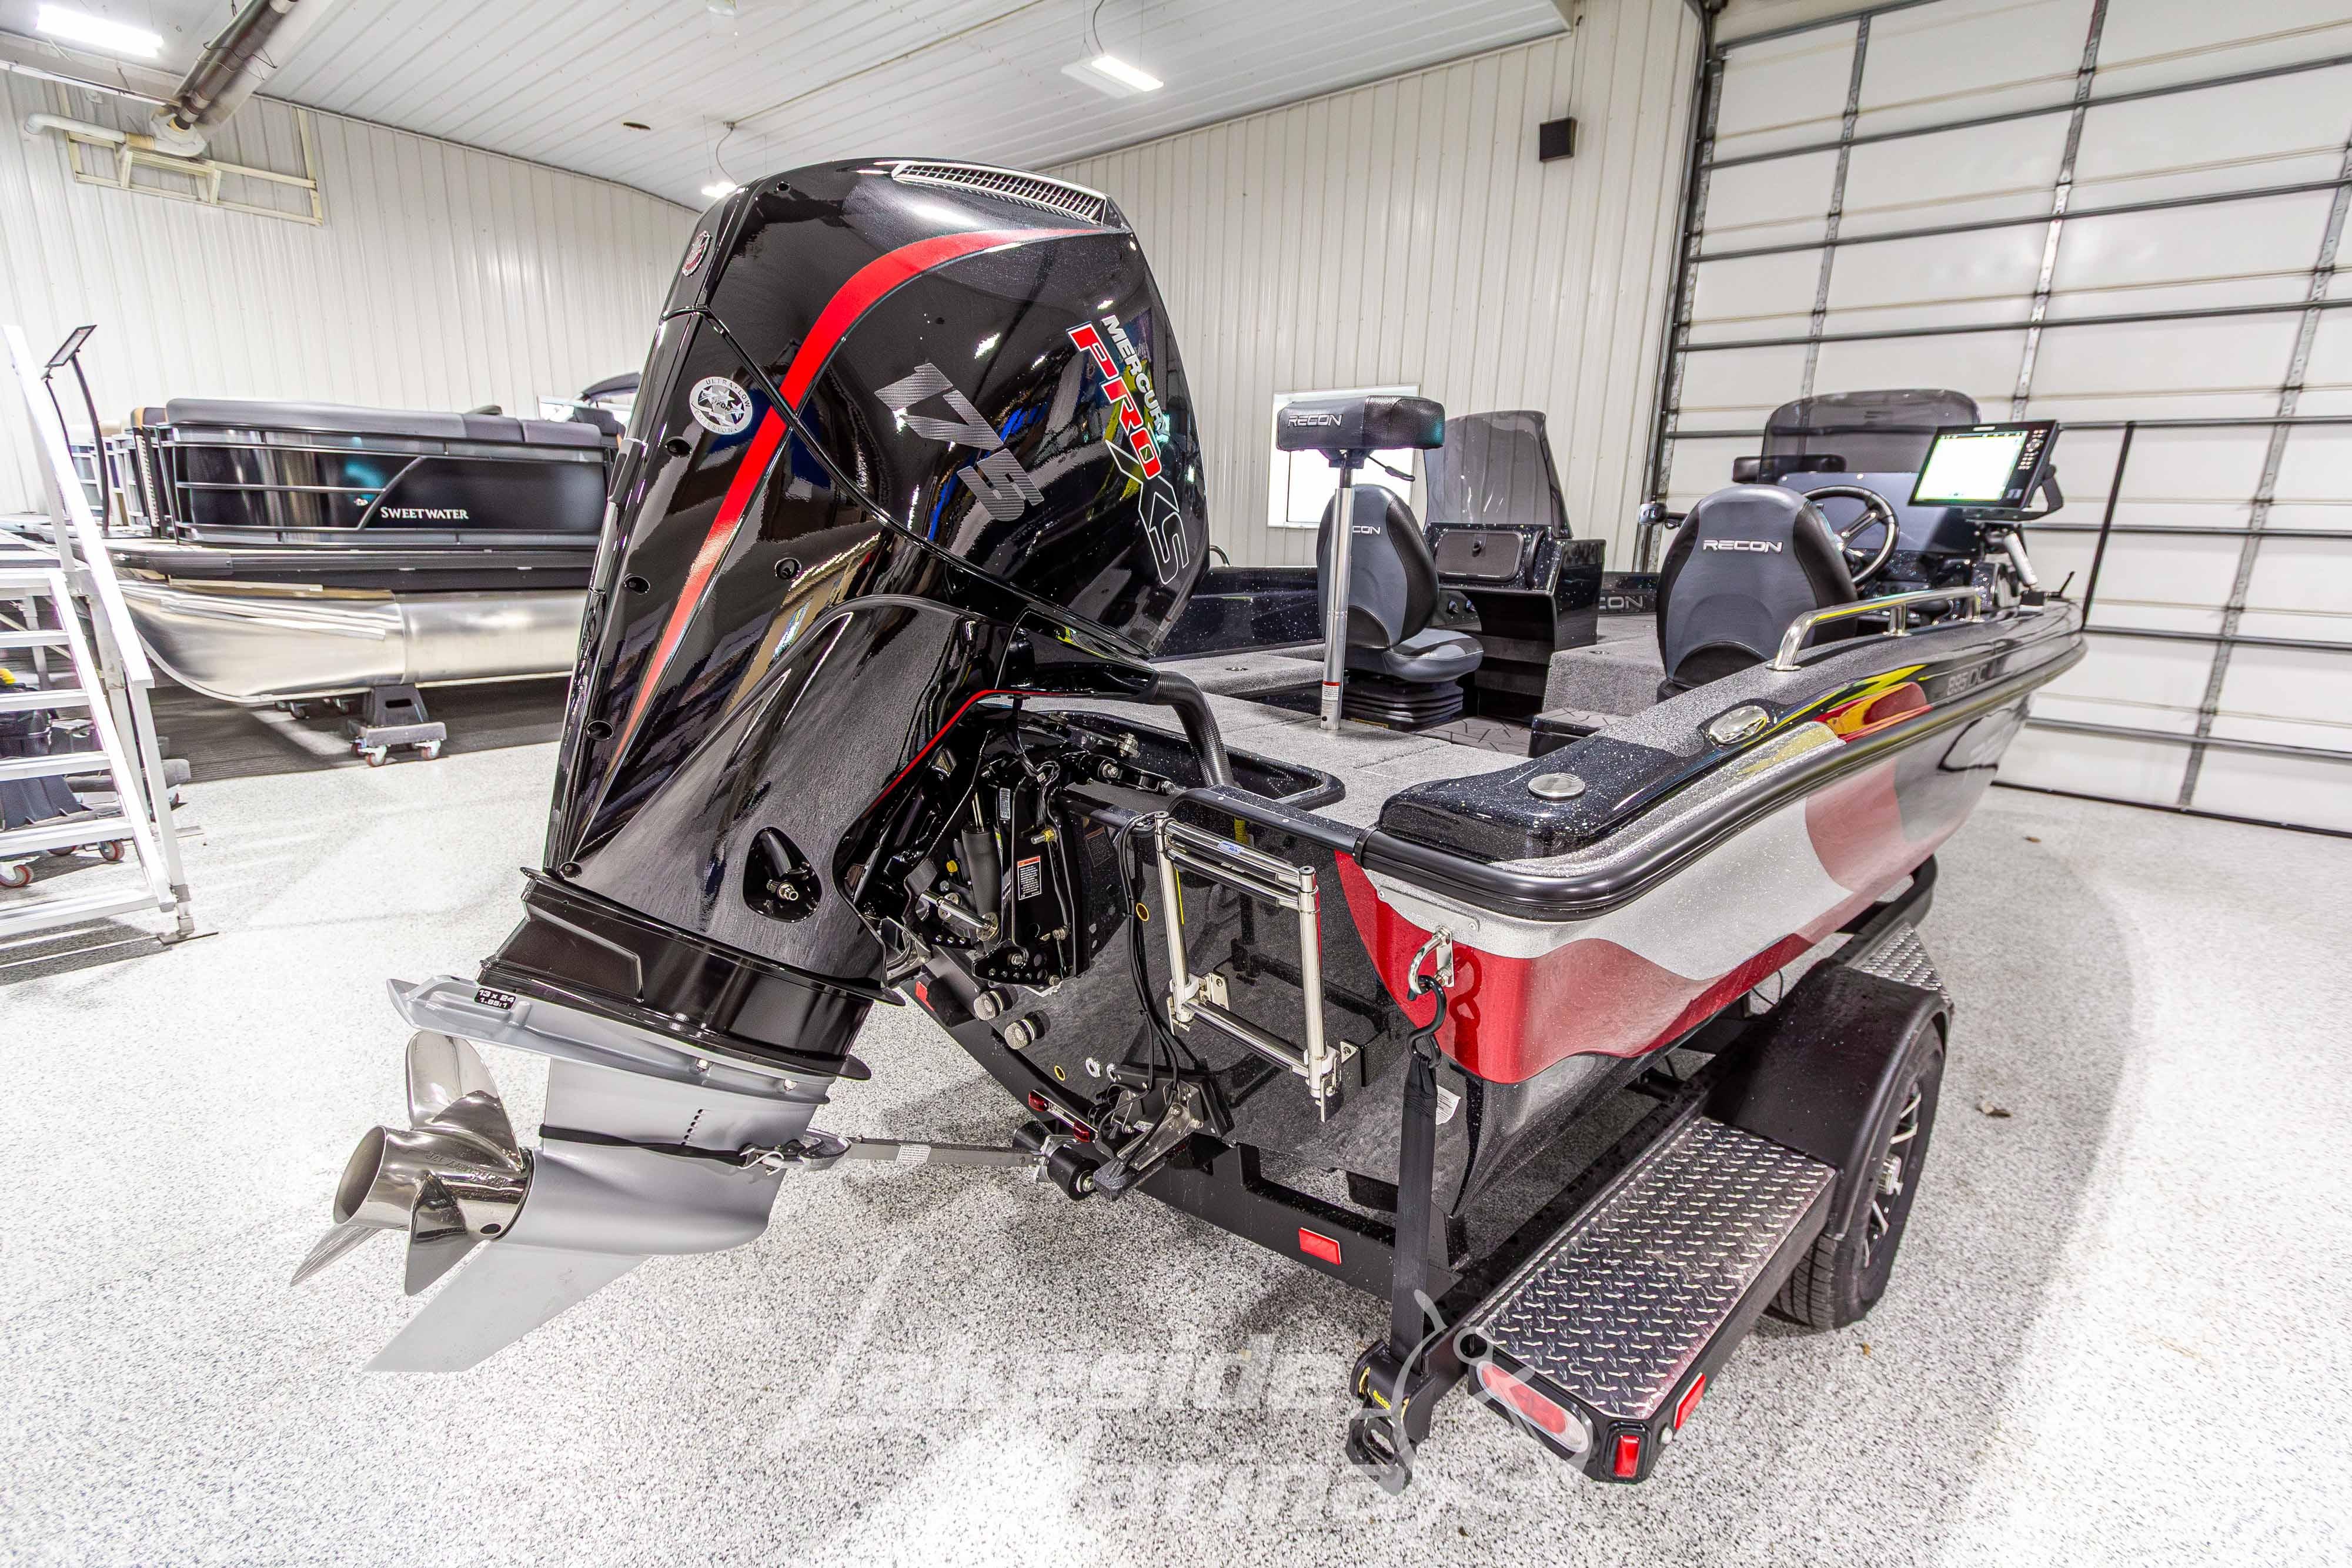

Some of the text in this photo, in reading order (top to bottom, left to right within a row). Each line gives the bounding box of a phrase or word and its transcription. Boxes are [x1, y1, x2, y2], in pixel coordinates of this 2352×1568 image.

[1101, 315, 1171, 436] MERCURY
[1288, 413, 1343, 427] RECON
[1066, 320, 1188, 584] PRO XS
[1352, 525, 1381, 535] CON
[1703, 540, 1783, 553] RECON
[499, 995, 514, 1003] 24
